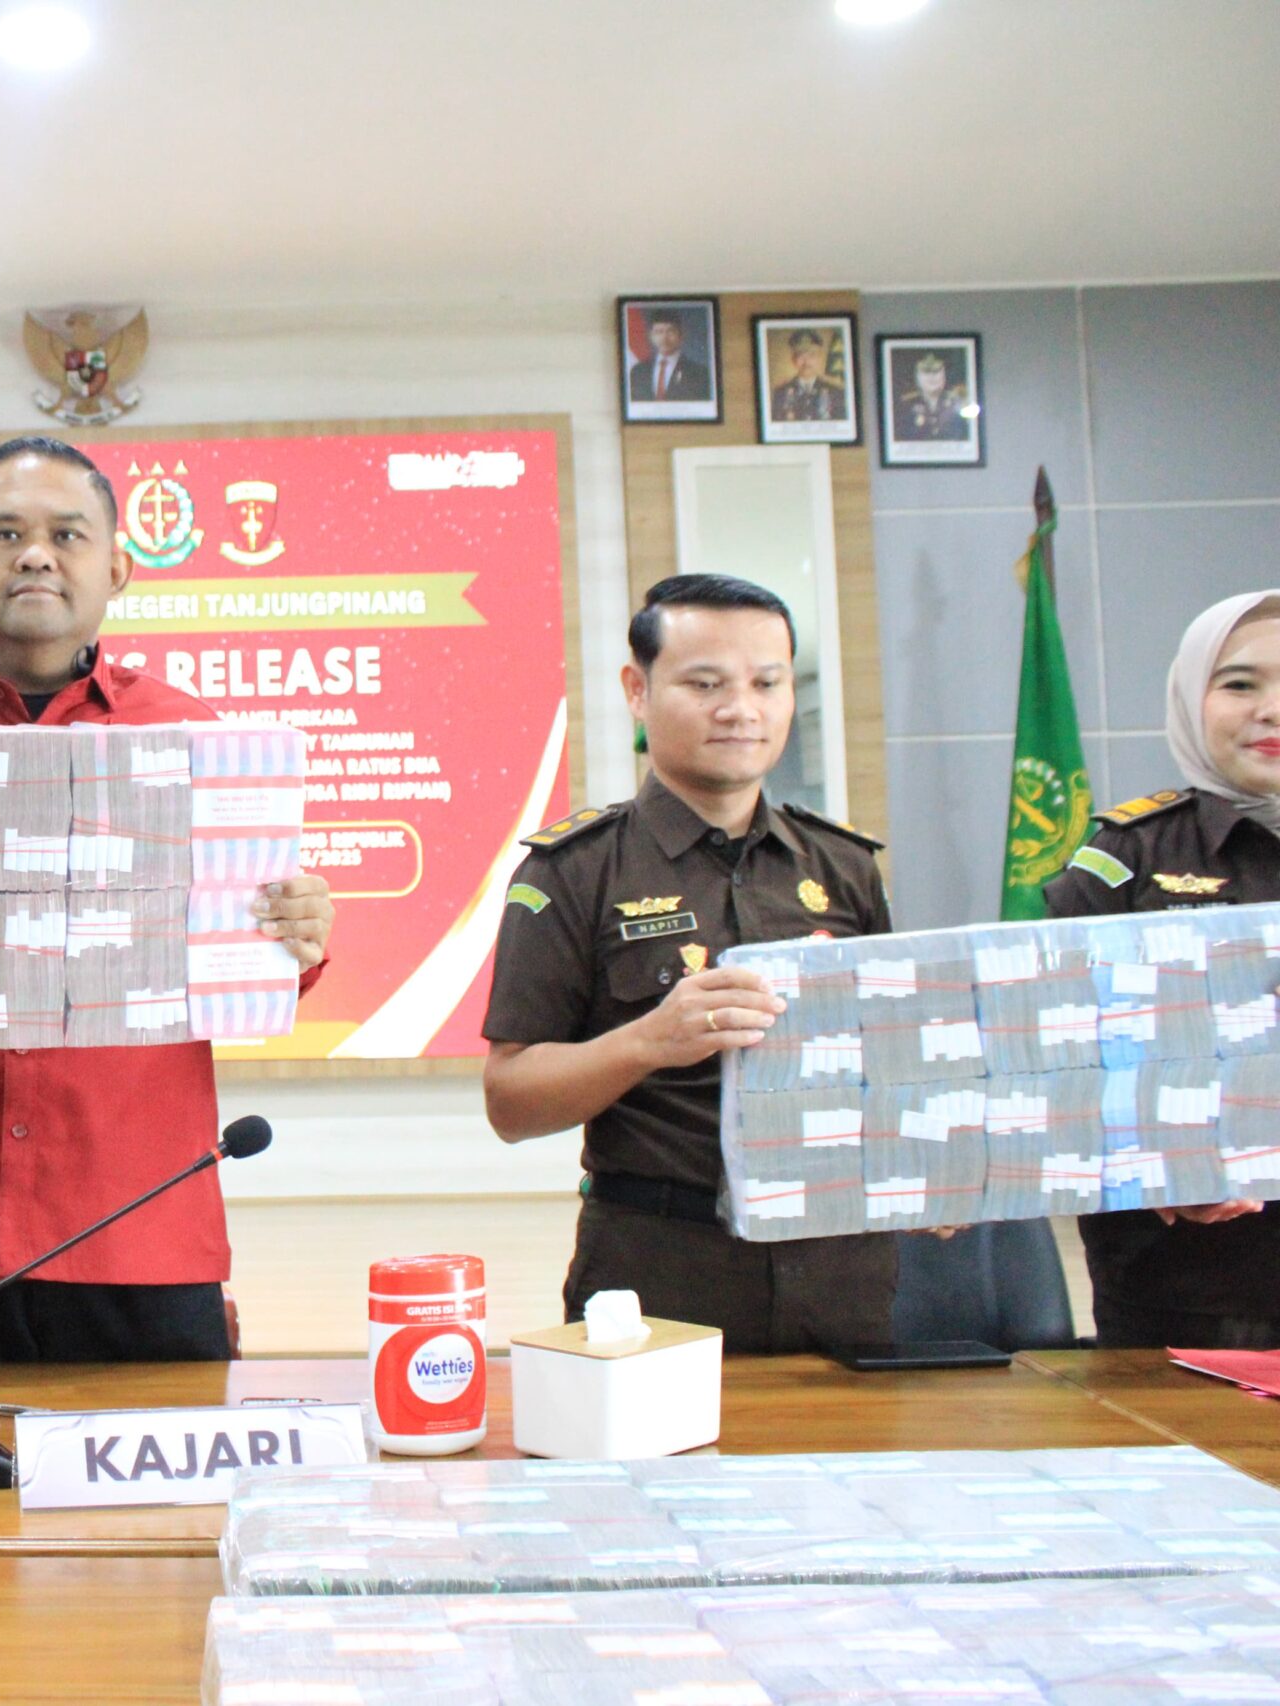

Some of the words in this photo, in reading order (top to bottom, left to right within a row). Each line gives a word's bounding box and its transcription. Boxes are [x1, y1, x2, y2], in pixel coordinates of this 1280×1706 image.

[106, 594, 199, 620] NEGERI
[204, 589, 426, 618] TANJUNGPINANG
[166, 646, 382, 698] RELEASE
[639, 919, 679, 933] NAPIT
[406, 1304, 442, 1316] GRATIS
[415, 1357, 473, 1377] Wetties
[84, 1429, 303, 1482] KAJARI
